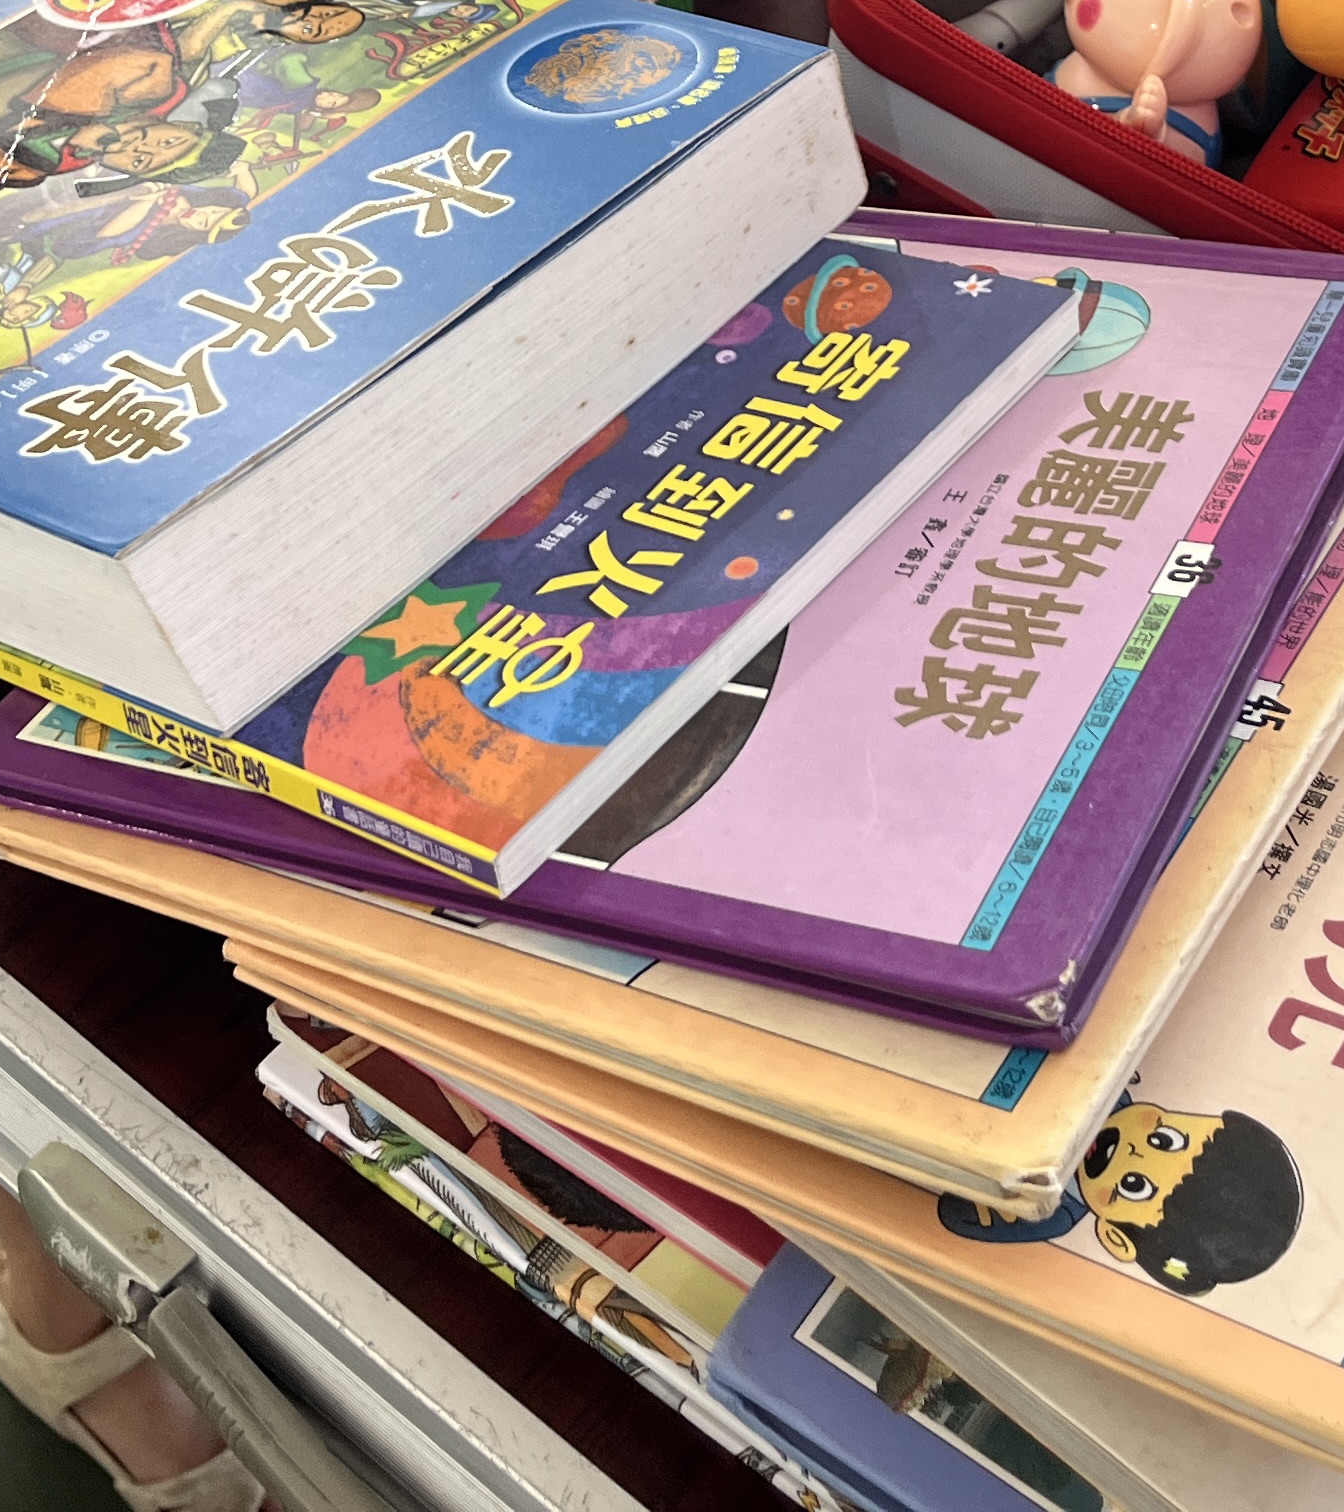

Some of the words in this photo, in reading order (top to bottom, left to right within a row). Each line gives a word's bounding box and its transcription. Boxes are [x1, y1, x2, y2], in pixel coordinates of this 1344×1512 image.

[20, 131, 514, 463] 水滸傳
[429, 331, 911, 708] 寄信到火星
[894, 390, 1195, 739] 美麗的地球
[1167, 554, 1222, 585] 36
[122, 701, 272, 793] 寄信到火星
[1237, 694, 1292, 732] 45
